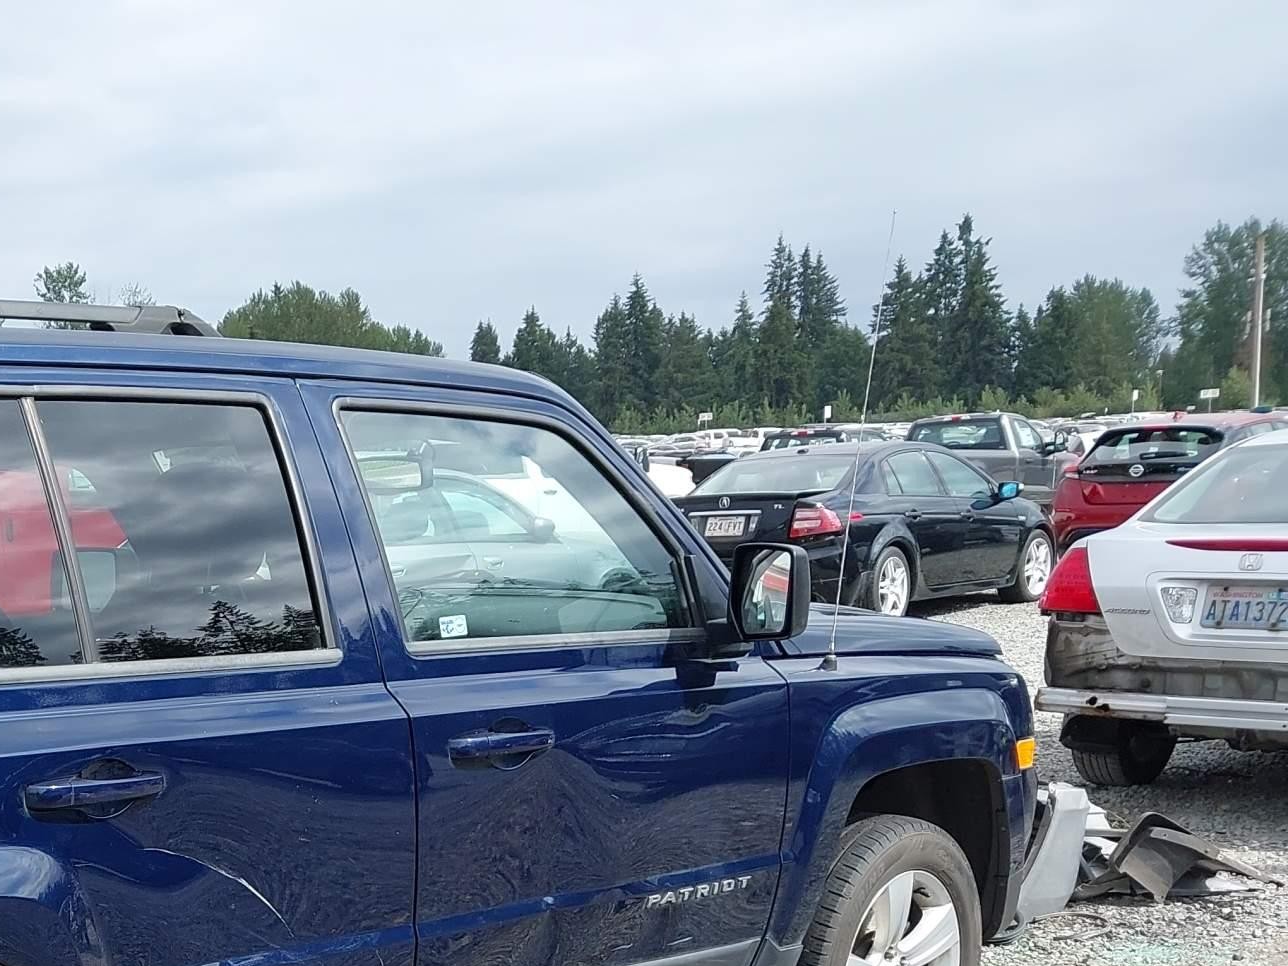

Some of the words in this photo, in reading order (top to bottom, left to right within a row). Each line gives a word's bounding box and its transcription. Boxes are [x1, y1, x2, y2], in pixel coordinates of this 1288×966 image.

[708, 522, 722, 532] 224
[1206, 599, 1288, 623] ATA1372
[646, 876, 752, 909] PATRIOT
